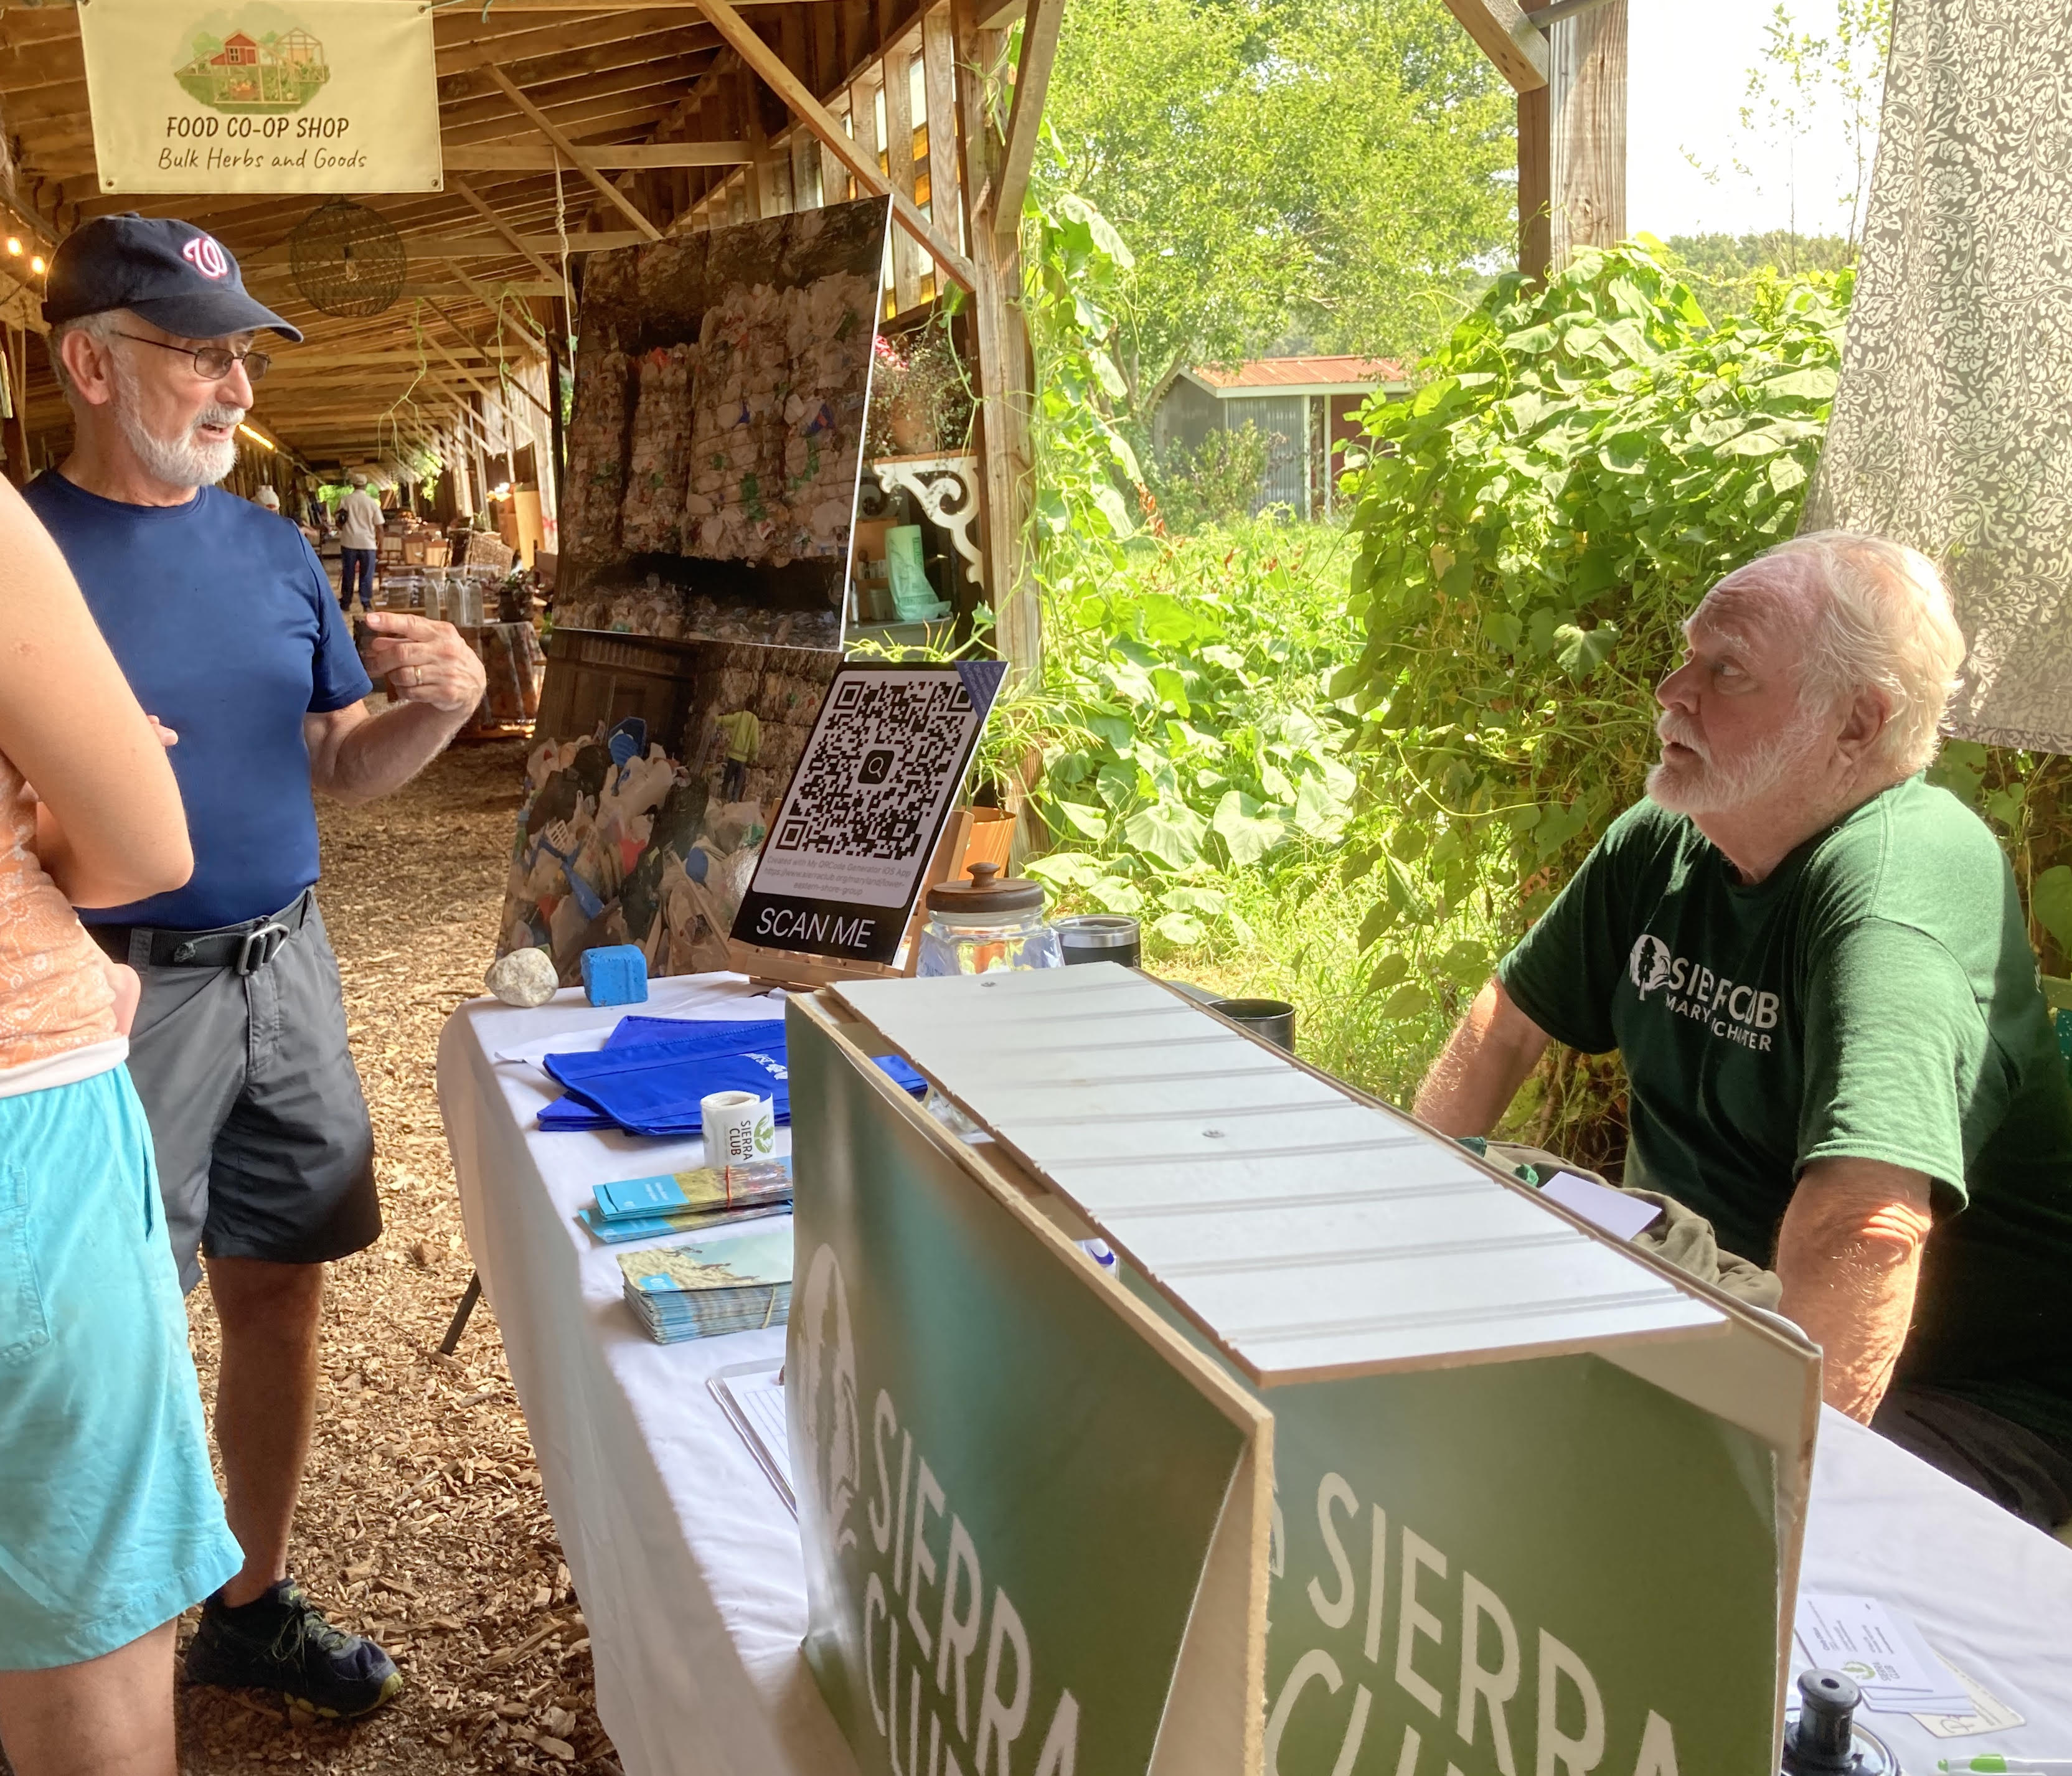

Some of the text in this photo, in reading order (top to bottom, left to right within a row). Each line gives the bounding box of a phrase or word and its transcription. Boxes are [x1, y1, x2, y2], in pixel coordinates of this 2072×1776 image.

[167, 116, 349, 138] FOOD CO-OP SHOP
[158, 146, 367, 171] Bulk Herbs and Goods
[182, 236, 228, 280] W
[895, 868, 911, 878] App
[756, 907, 876, 948] SCAN ME
[729, 1128, 742, 1156] CLUB
[740, 1120, 753, 1161] SIERRA
